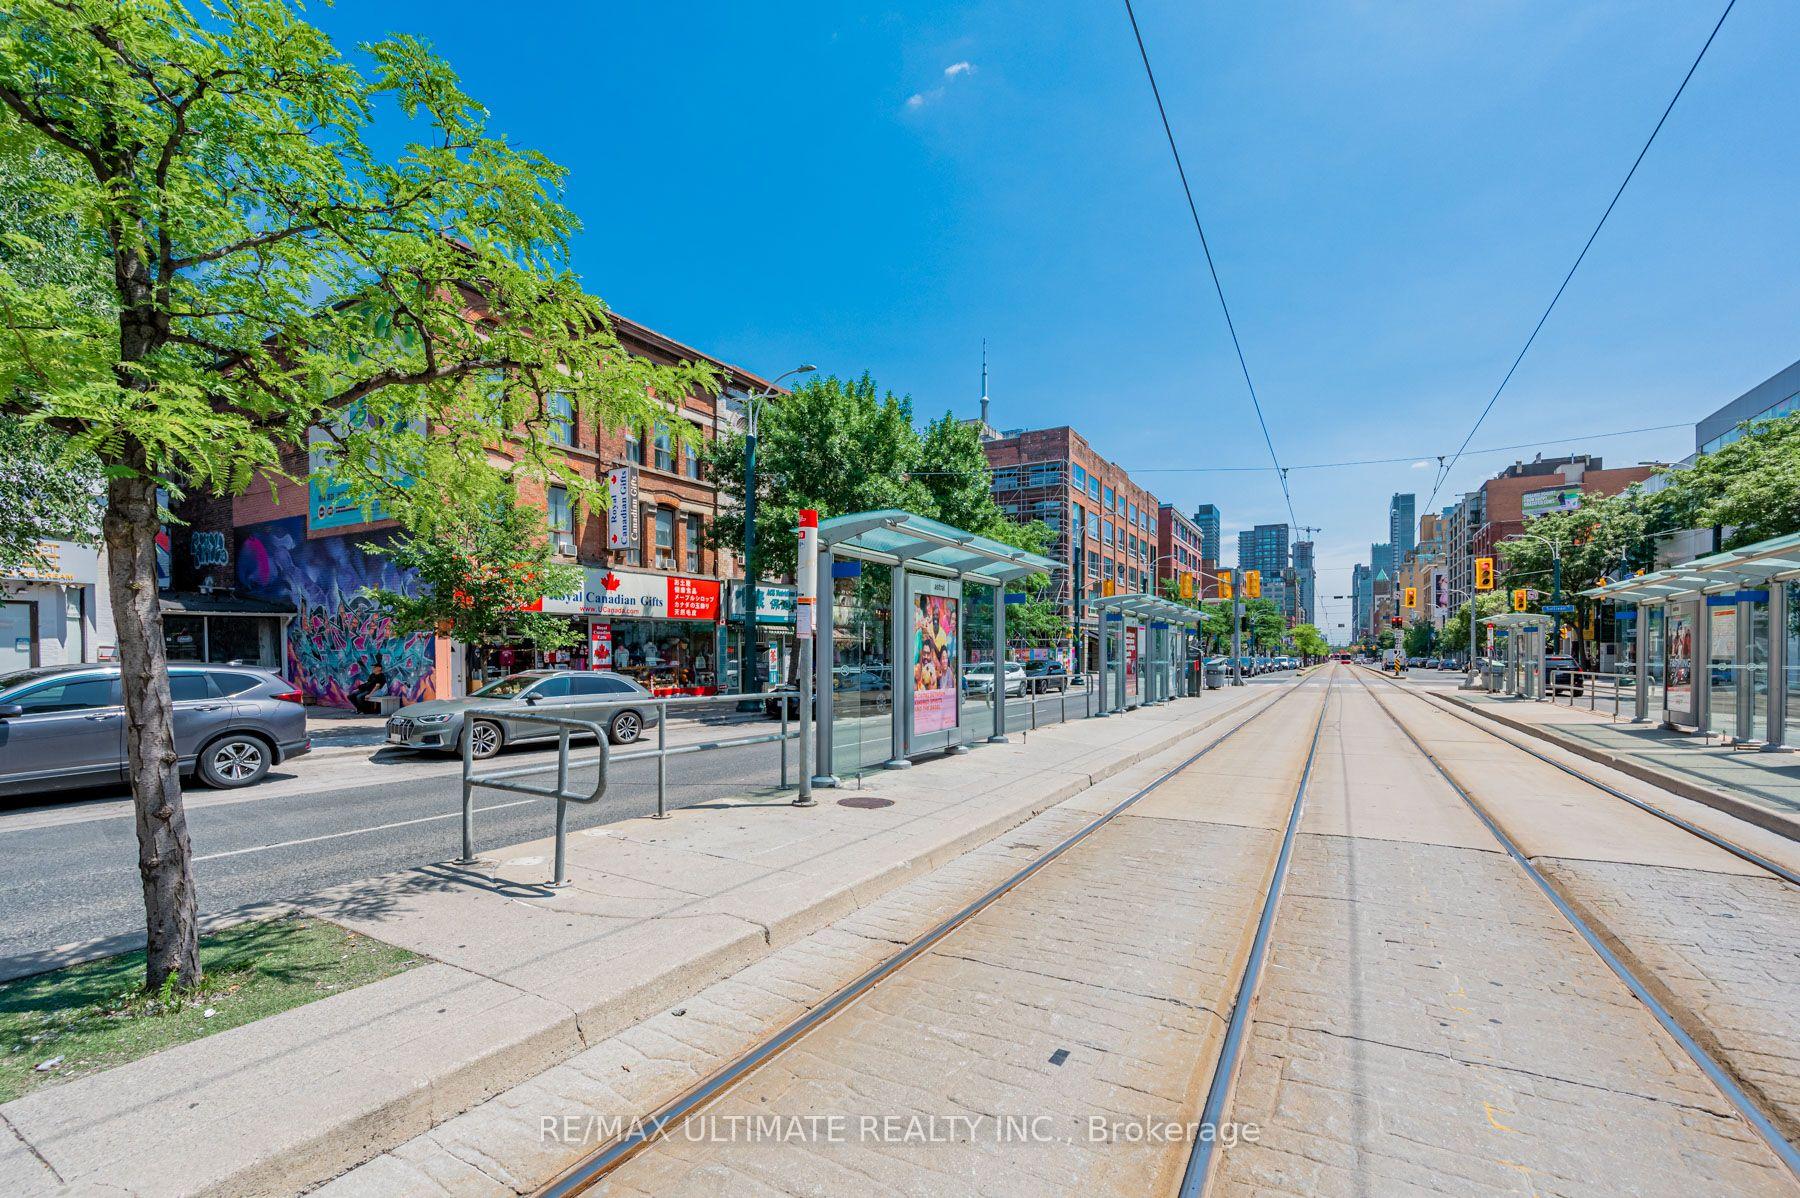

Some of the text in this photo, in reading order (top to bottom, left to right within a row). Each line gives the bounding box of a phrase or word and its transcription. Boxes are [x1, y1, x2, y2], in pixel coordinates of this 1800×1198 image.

[586, 591, 636, 606] Canadian
[640, 595, 663, 607] Gifts
[675, 594, 714, 603] メープルシロップ
[579, 606, 640, 615] www.UCanada.com
